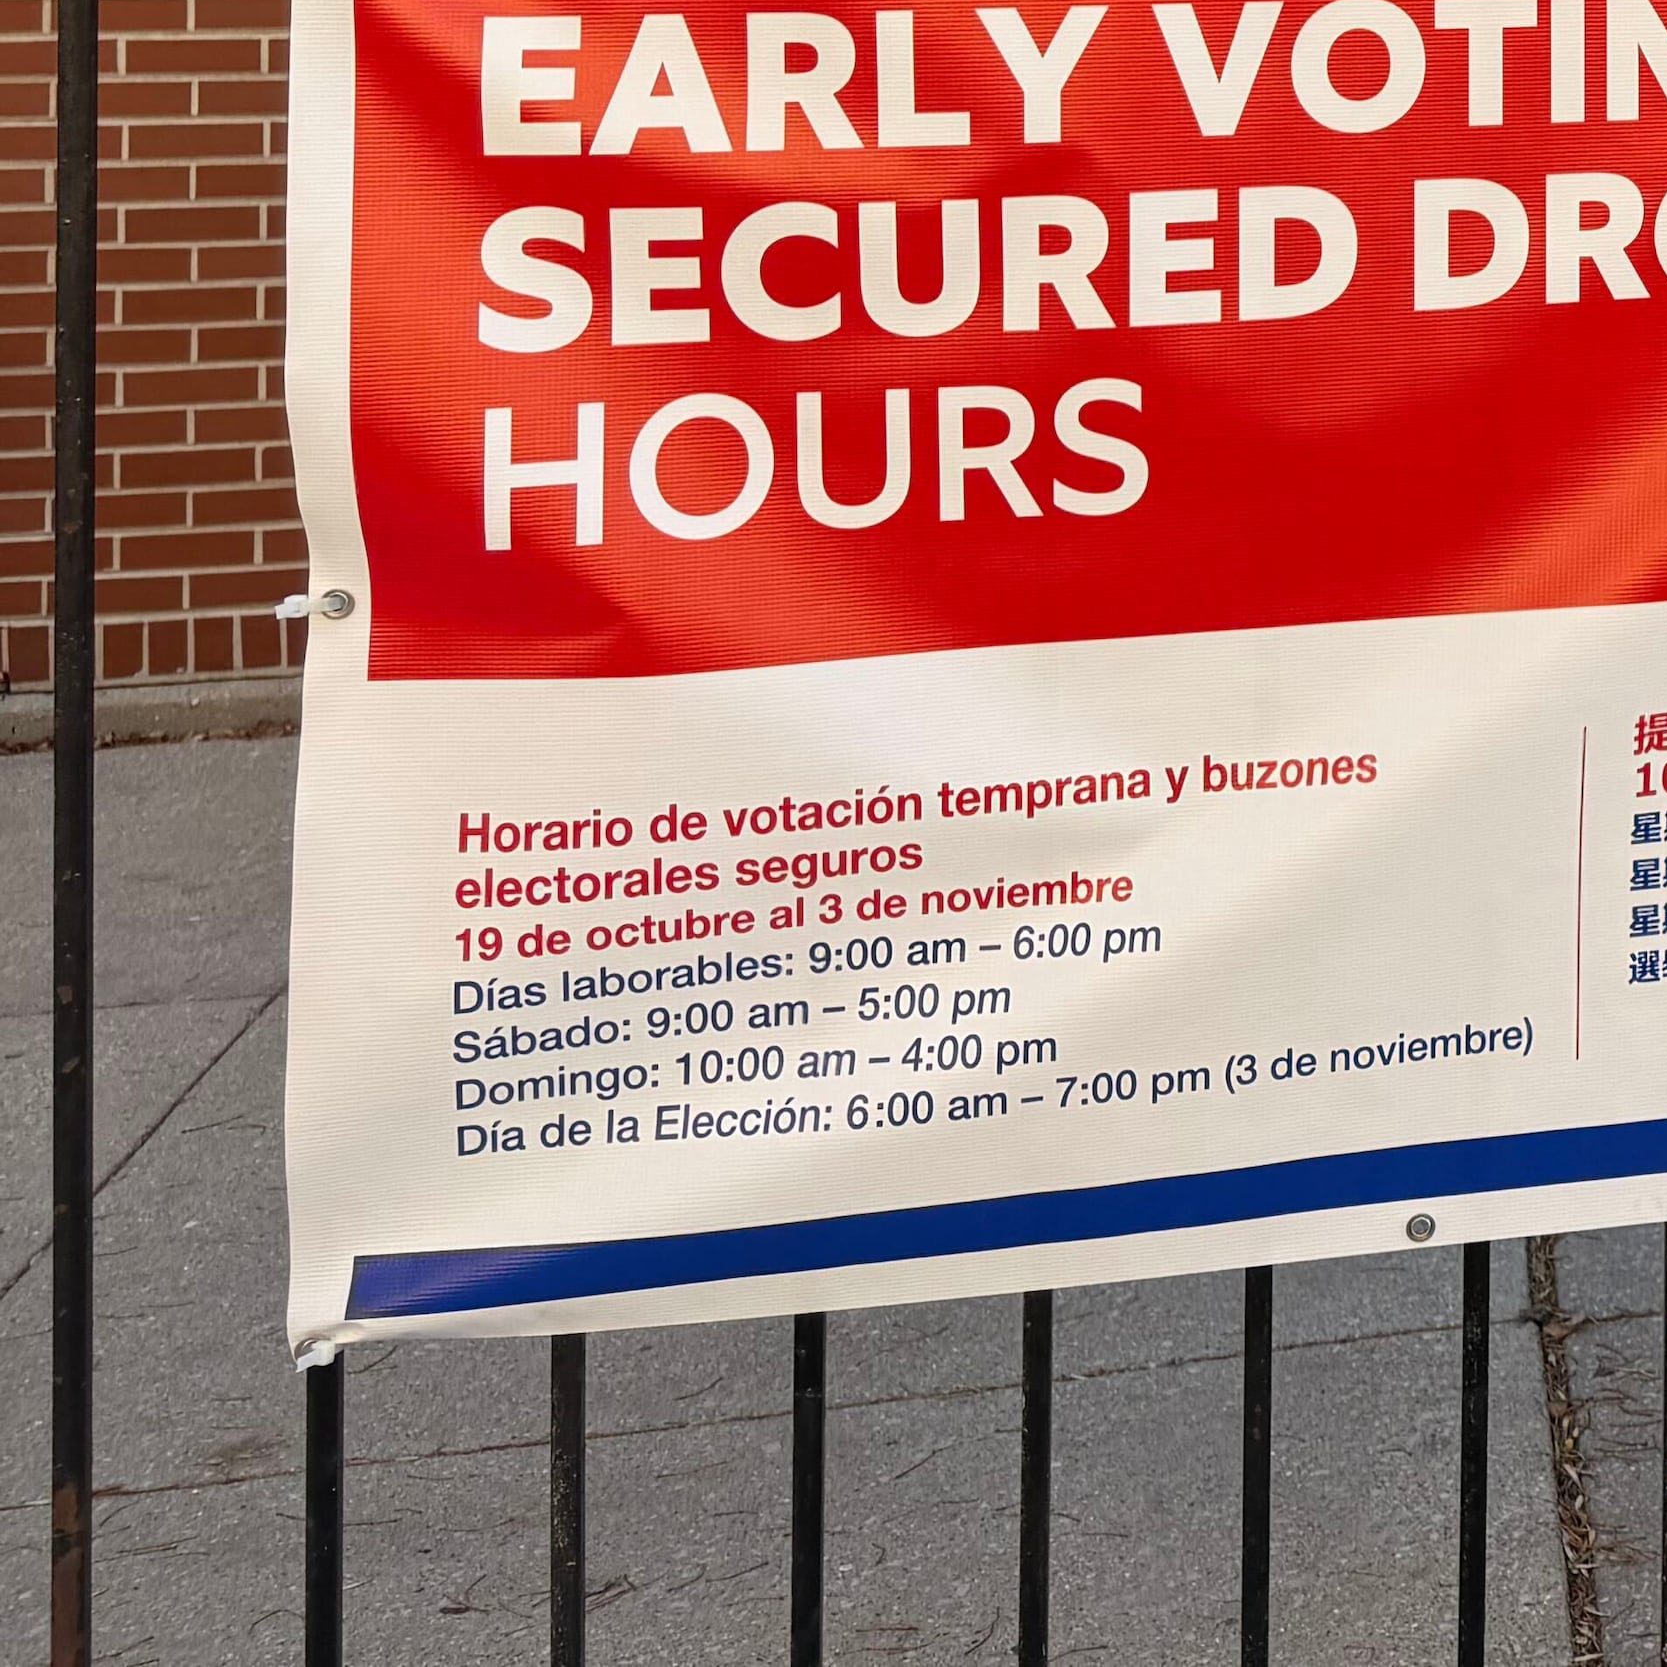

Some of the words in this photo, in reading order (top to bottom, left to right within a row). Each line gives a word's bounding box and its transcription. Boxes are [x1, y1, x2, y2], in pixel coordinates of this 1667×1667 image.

[482, 6, 1107, 155] EARLY
[479, 187, 1357, 353] SECURED
[484, 379, 1148, 550] HOURS
[459, 809, 633, 853] Horario
[650, 804, 707, 843] de
[723, 785, 922, 837] votación
[937, 769, 1150, 819] temprana
[1165, 766, 1189, 804] y
[1203, 754, 1377, 792] buzones
[455, 857, 719, 909] electorales
[736, 843, 923, 889] seguros
[456, 927, 502, 961] 19
[517, 924, 571, 958] de
[586, 909, 755, 950] octubre
[770, 897, 804, 930] al
[819, 894, 843, 924] 3
[856, 889, 907, 921] de
[922, 871, 1133, 915] noviembre
[454, 978, 546, 1014] Días
[563, 951, 793, 1002] laborables:
[809, 936, 892, 974] 9:00
[907, 938, 965, 966] am
[1014, 923, 1091, 959] 6:00
[1103, 927, 1160, 963] pm
[453, 1016, 630, 1063] Sábado:
[647, 1000, 733, 1038] 9:00
[748, 1001, 808, 1029] am
[858, 983, 939, 1021] 5:00
[952, 988, 1010, 1025] pm
[456, 1064, 659, 1110] Domingo:
[676, 1046, 784, 1085] 10:00
[797, 1050, 855, 1078] am
[901, 1034, 982, 1072] 4:00
[997, 1038, 1056, 1075] pm
[457, 1120, 526, 1156] Día
[540, 1114, 591, 1148] de
[607, 1109, 639, 1143] la
[655, 1097, 832, 1140] Elección:
[847, 1091, 933, 1130] 6:00
[948, 1092, 1007, 1121] am
[1056, 1070, 1137, 1108] 7:00
[1152, 1068, 1210, 1104] pm
[1226, 1054, 1257, 1094] (3
[1271, 1048, 1316, 1080] de
[1331, 1017, 1532, 1072] noviembre)
